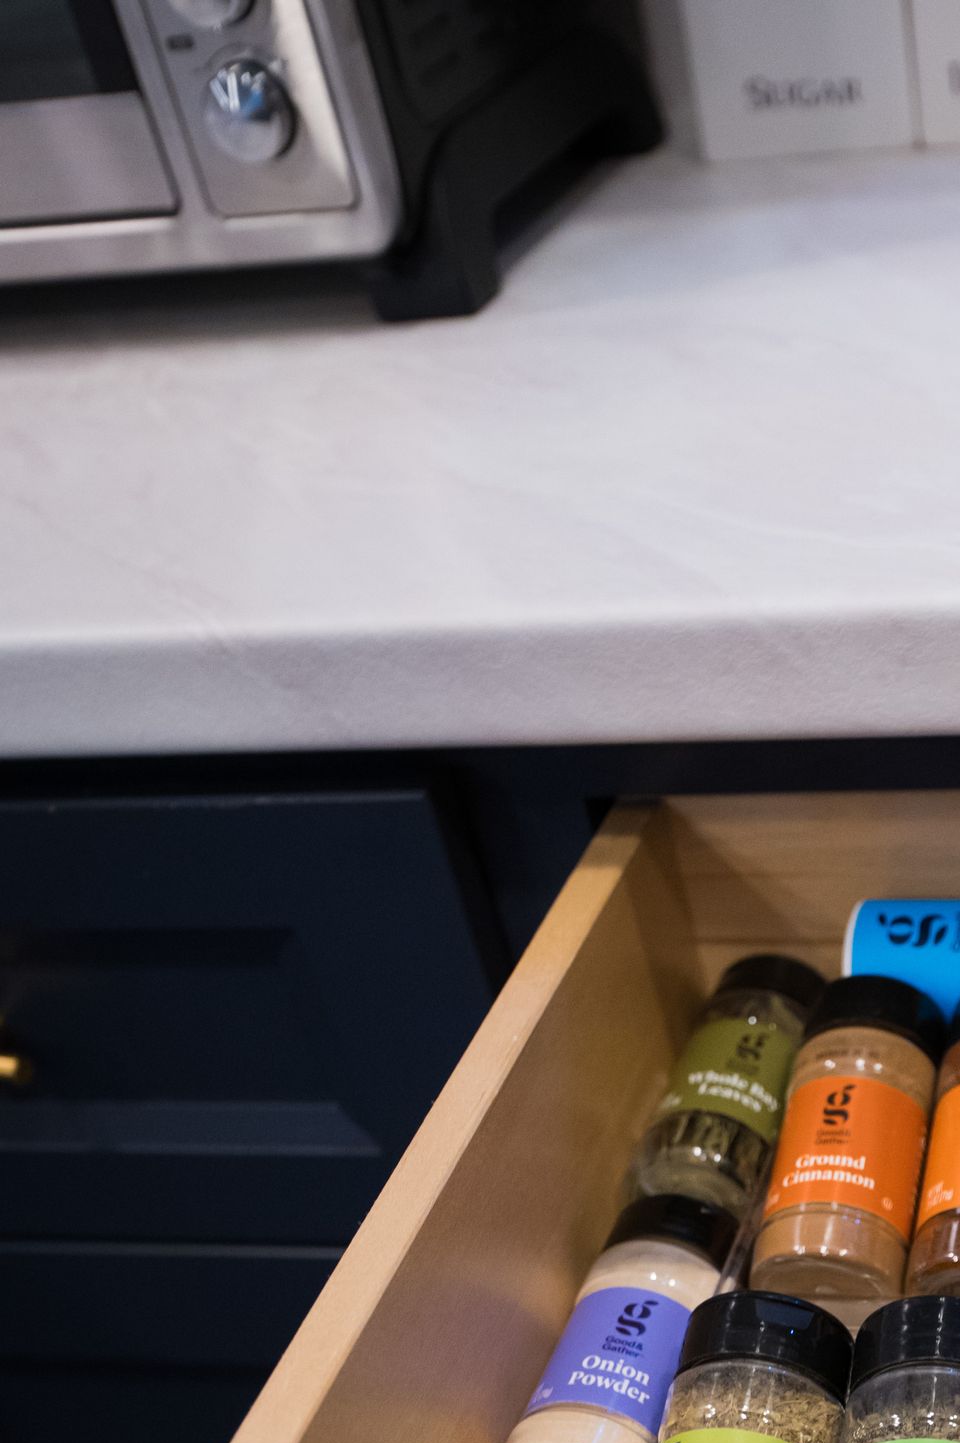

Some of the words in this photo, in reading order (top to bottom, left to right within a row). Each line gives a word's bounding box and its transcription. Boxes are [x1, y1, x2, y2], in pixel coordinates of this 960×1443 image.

[795, 1154, 866, 1171] Ground
[782, 1170, 875, 1190] Cinnamon
[582, 1354, 650, 1386] Onion
[568, 1370, 650, 1405] Powder
